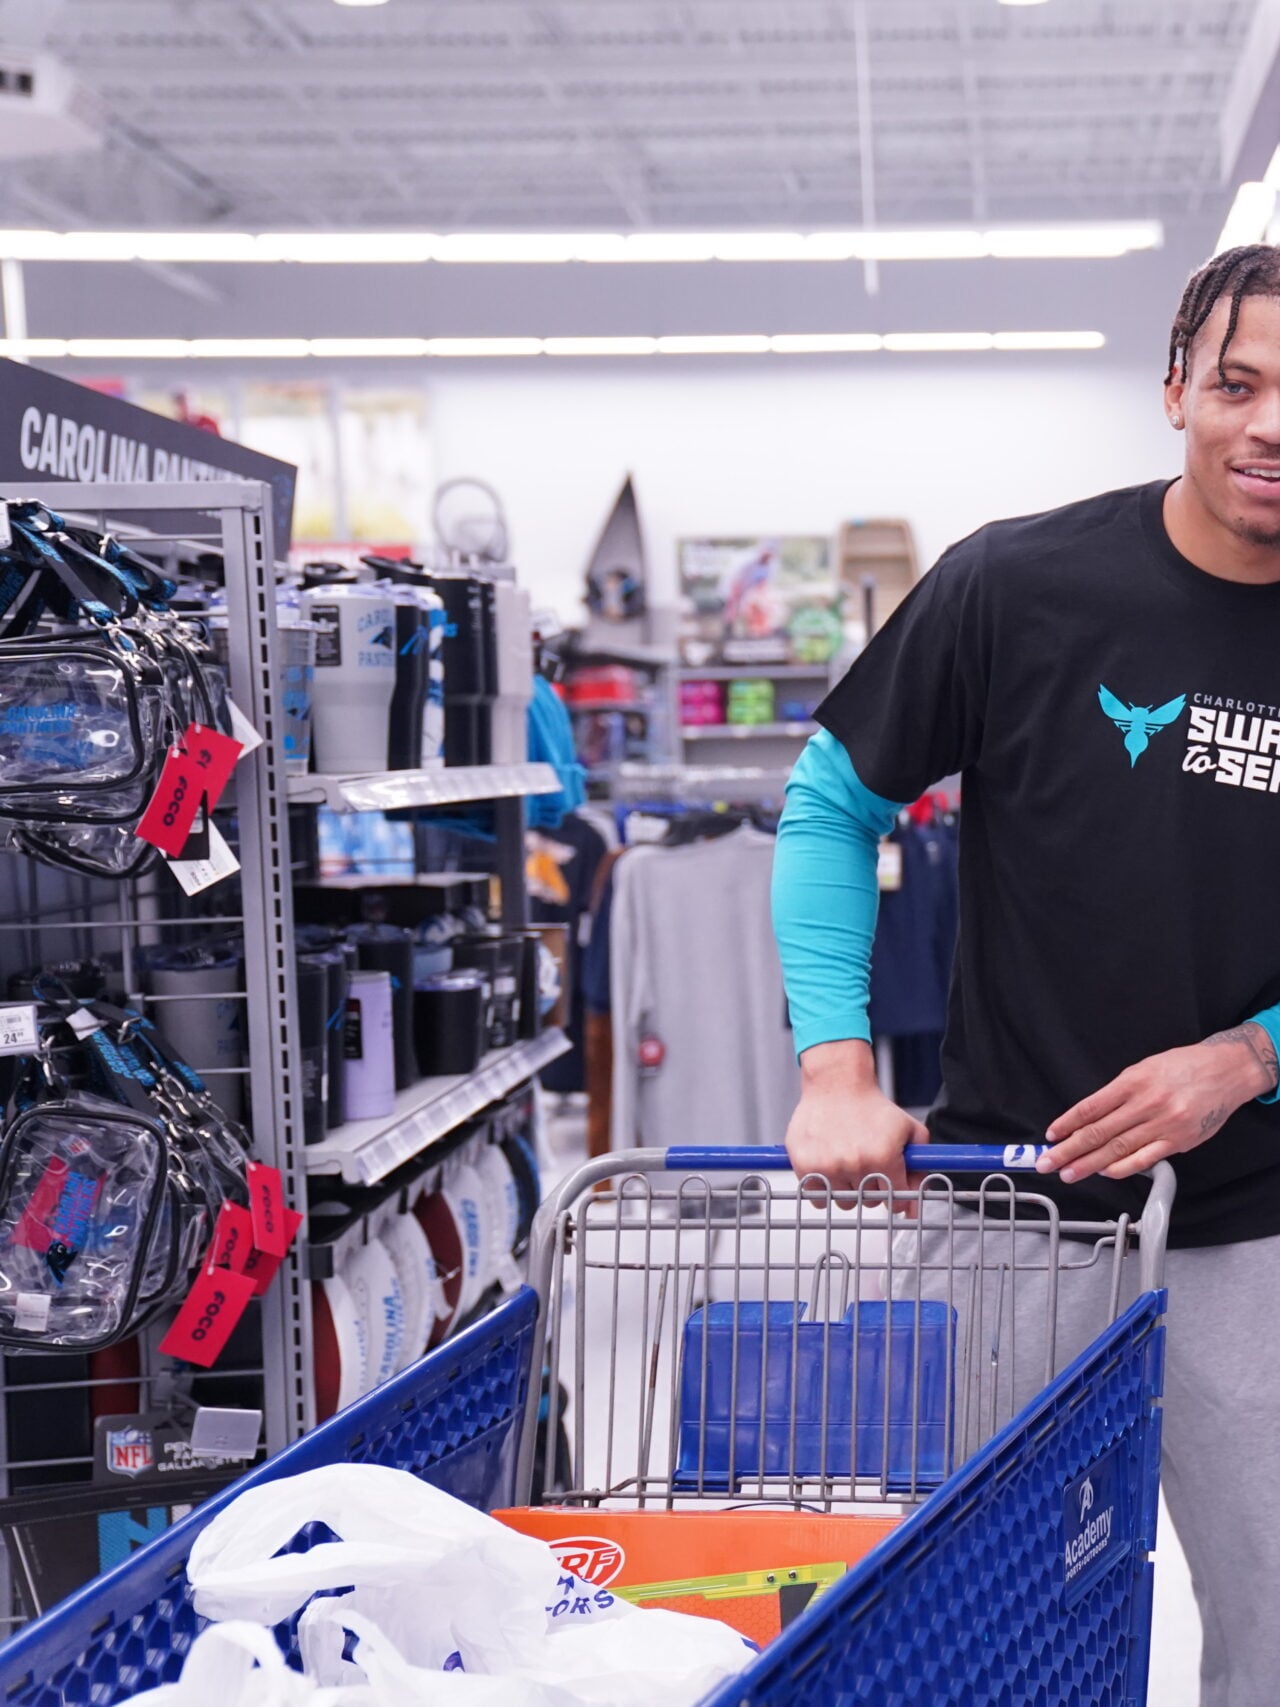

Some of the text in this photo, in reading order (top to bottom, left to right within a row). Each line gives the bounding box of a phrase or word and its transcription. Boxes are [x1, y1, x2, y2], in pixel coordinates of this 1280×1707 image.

[20, 406, 149, 483] CAROLINA
[1181, 744, 1218, 775] to
[162, 775, 188, 827] FOCO
[261, 1184, 275, 1234] FOCO
[220, 1227, 239, 1265] FOC
[191, 1290, 226, 1342] FOCO
[114, 1445, 153, 1469] NFL
[555, 1546, 618, 1581] RF
[1065, 1508, 1113, 1569] Academy
